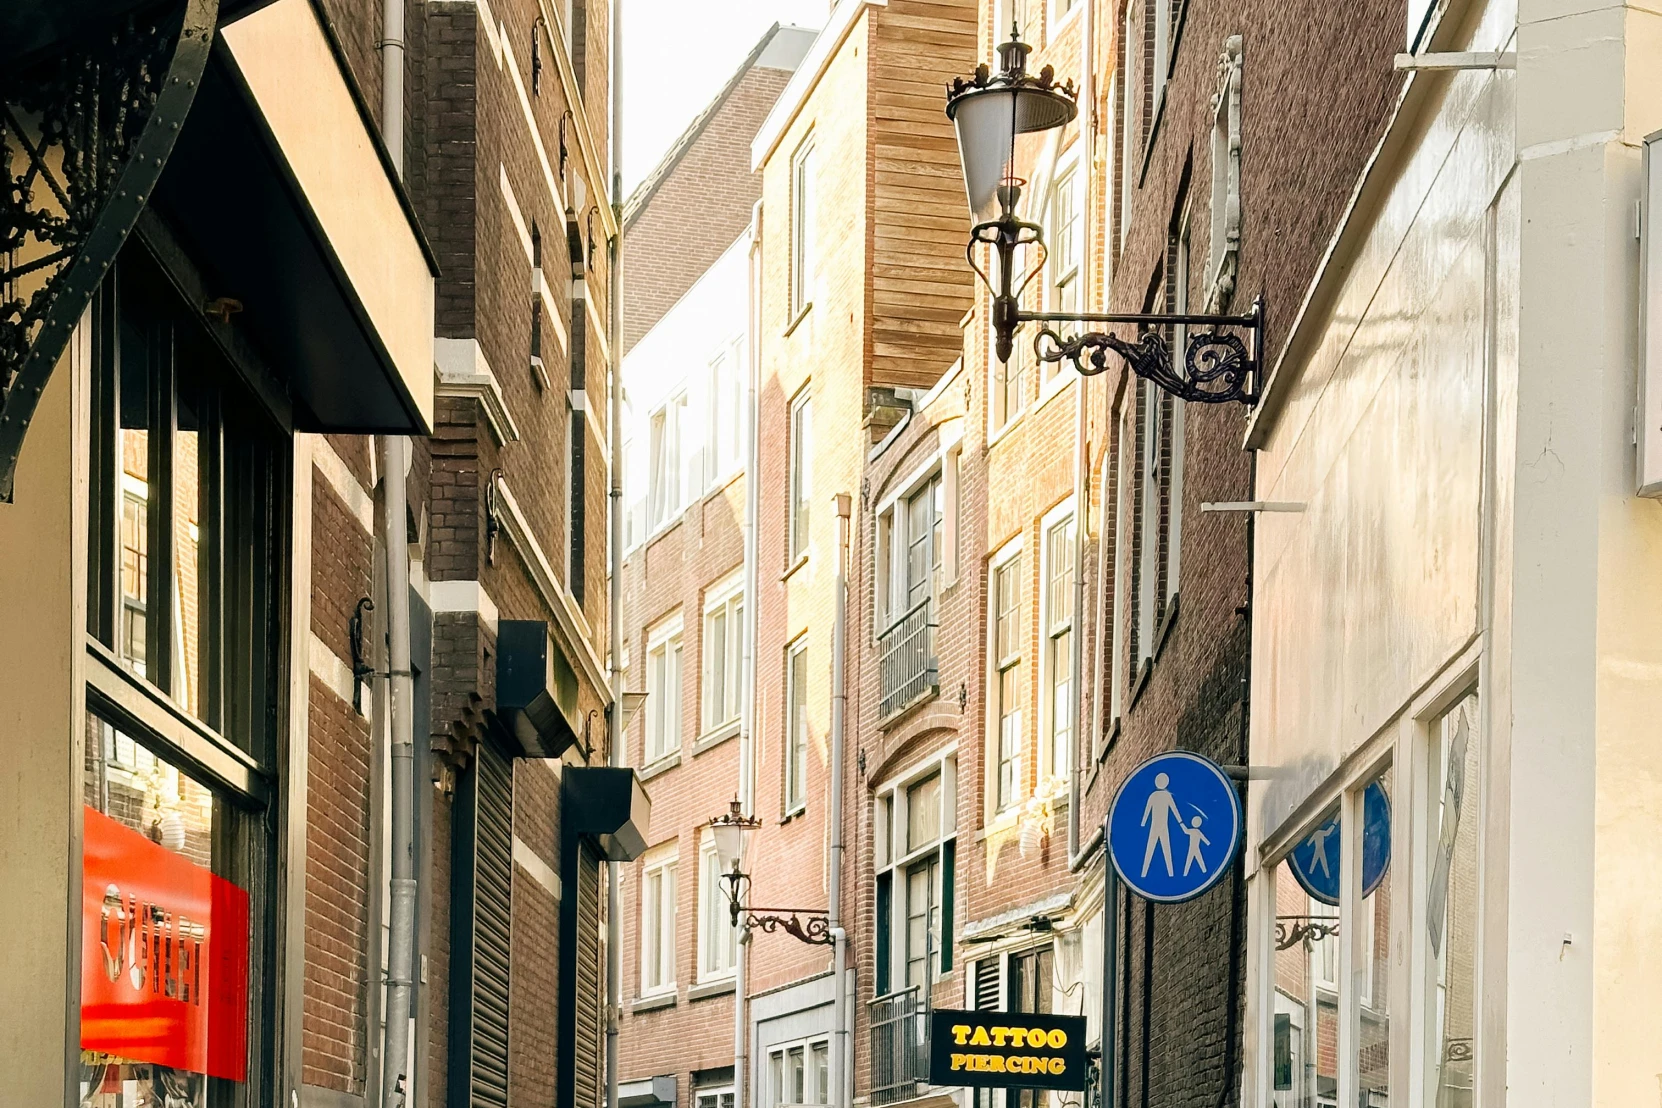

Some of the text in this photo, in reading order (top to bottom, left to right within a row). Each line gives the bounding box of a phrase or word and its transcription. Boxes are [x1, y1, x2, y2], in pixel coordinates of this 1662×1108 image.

[101, 883, 205, 1006] OUTLET
[951, 1025, 1068, 1049] TATTOO
[950, 1053, 1066, 1075] PIERCING
